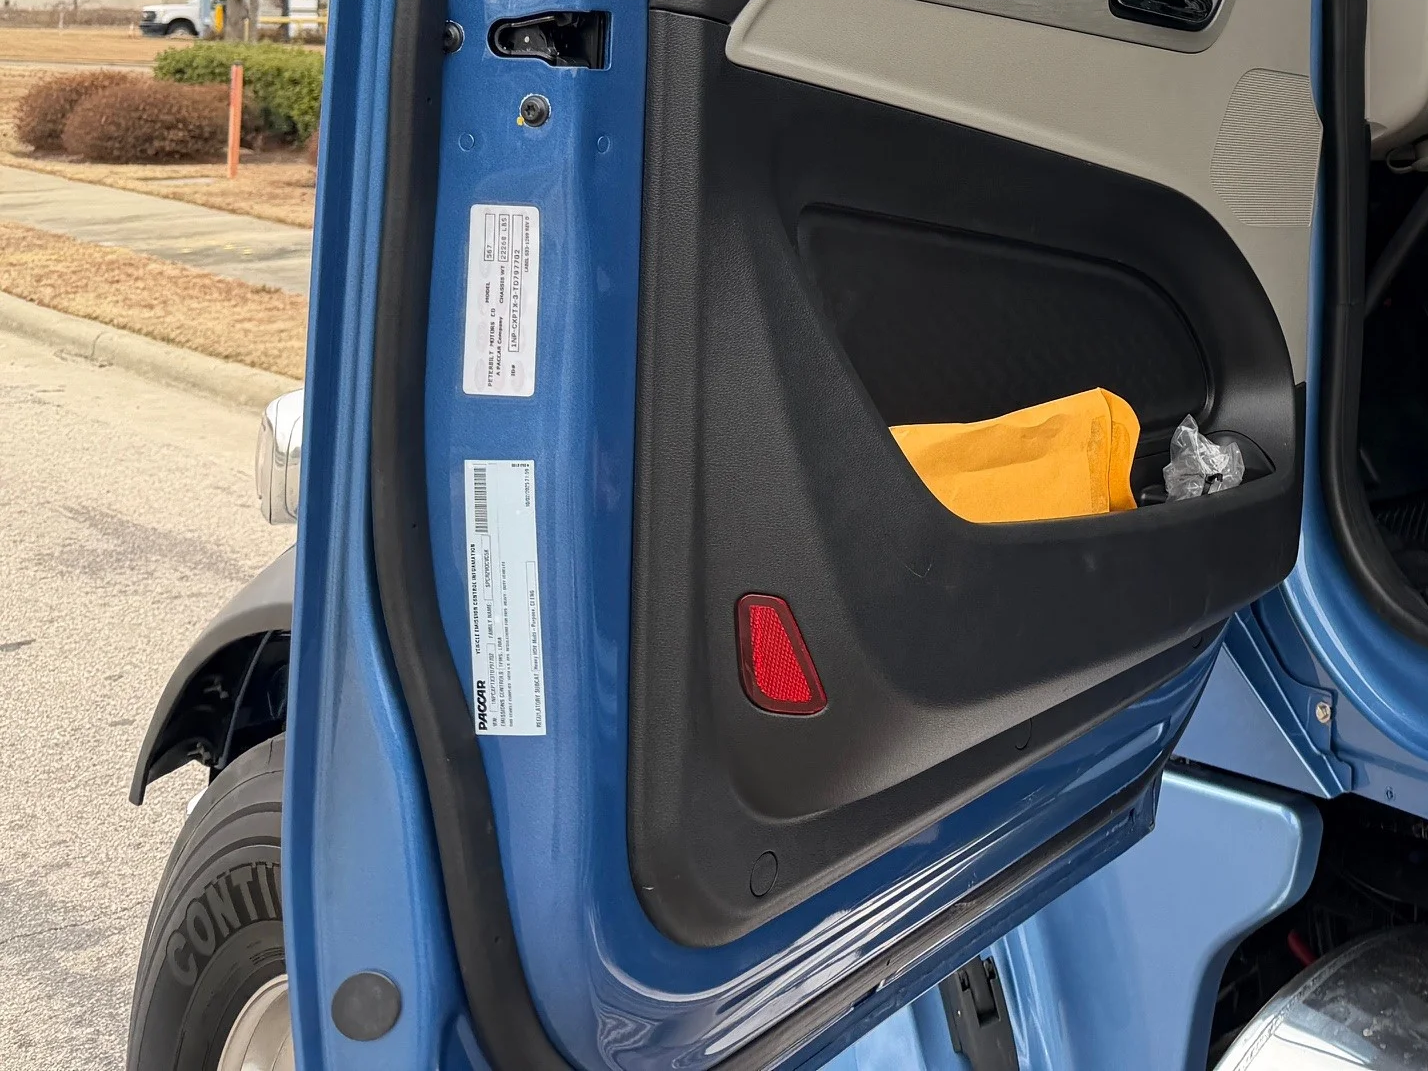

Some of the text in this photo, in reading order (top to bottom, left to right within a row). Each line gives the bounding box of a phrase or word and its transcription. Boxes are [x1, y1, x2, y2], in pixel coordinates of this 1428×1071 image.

[500, 266, 505, 275] WT
[491, 308, 496, 317] CO
[477, 680, 488, 731] PACCAR
